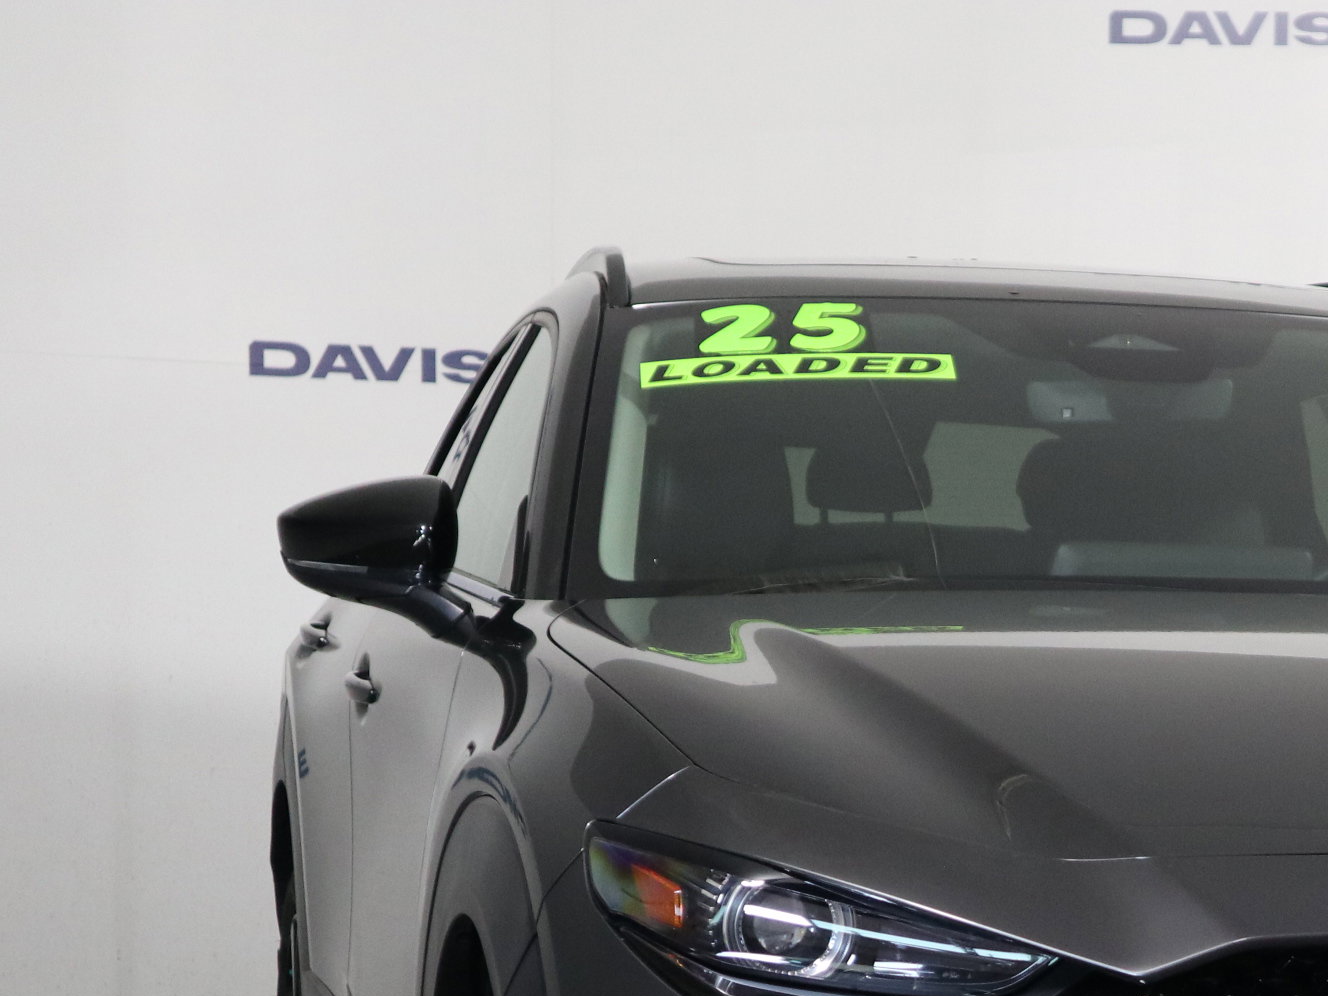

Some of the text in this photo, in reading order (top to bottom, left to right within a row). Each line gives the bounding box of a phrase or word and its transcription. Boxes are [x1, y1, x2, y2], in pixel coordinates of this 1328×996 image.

[698, 301, 867, 353] 25
[248, 339, 489, 385] DAVIS
[647, 355, 946, 384] LOADED
